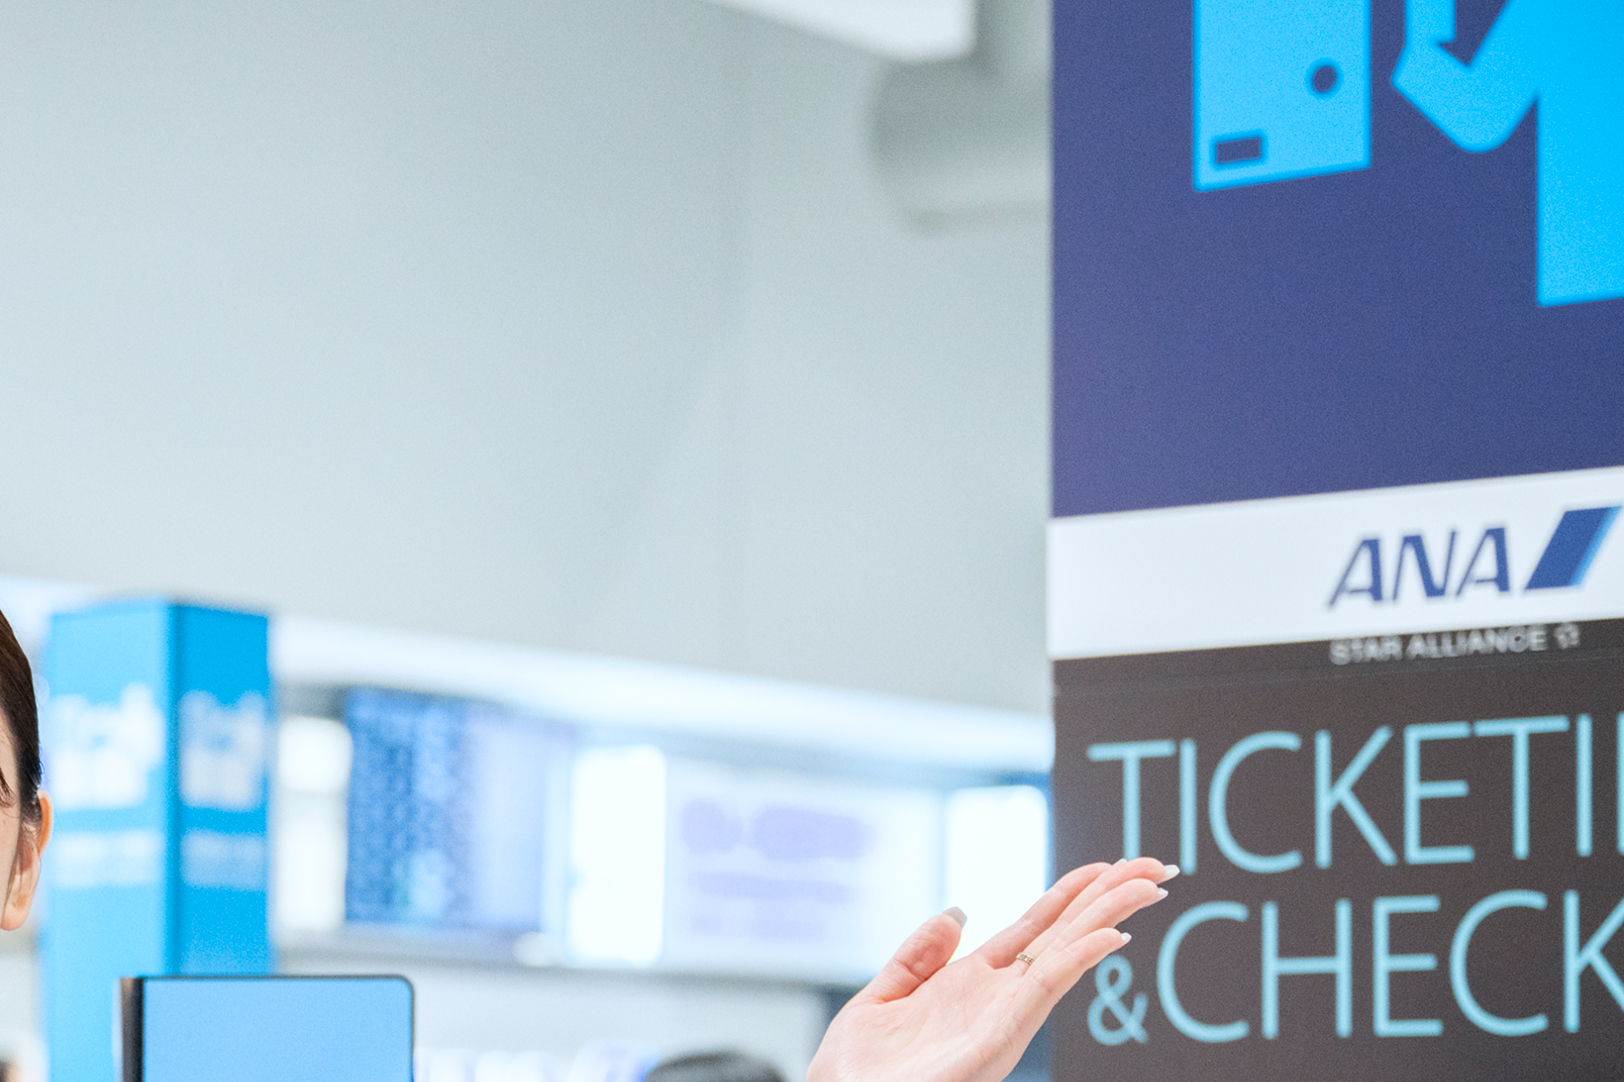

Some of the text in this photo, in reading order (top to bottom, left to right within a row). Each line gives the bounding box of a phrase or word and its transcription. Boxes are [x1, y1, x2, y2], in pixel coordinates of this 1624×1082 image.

[1327, 527, 1511, 609] ANA
[1329, 625, 1548, 666] STAR ALLIANCE
[1086, 711, 1624, 875] TICKETI
